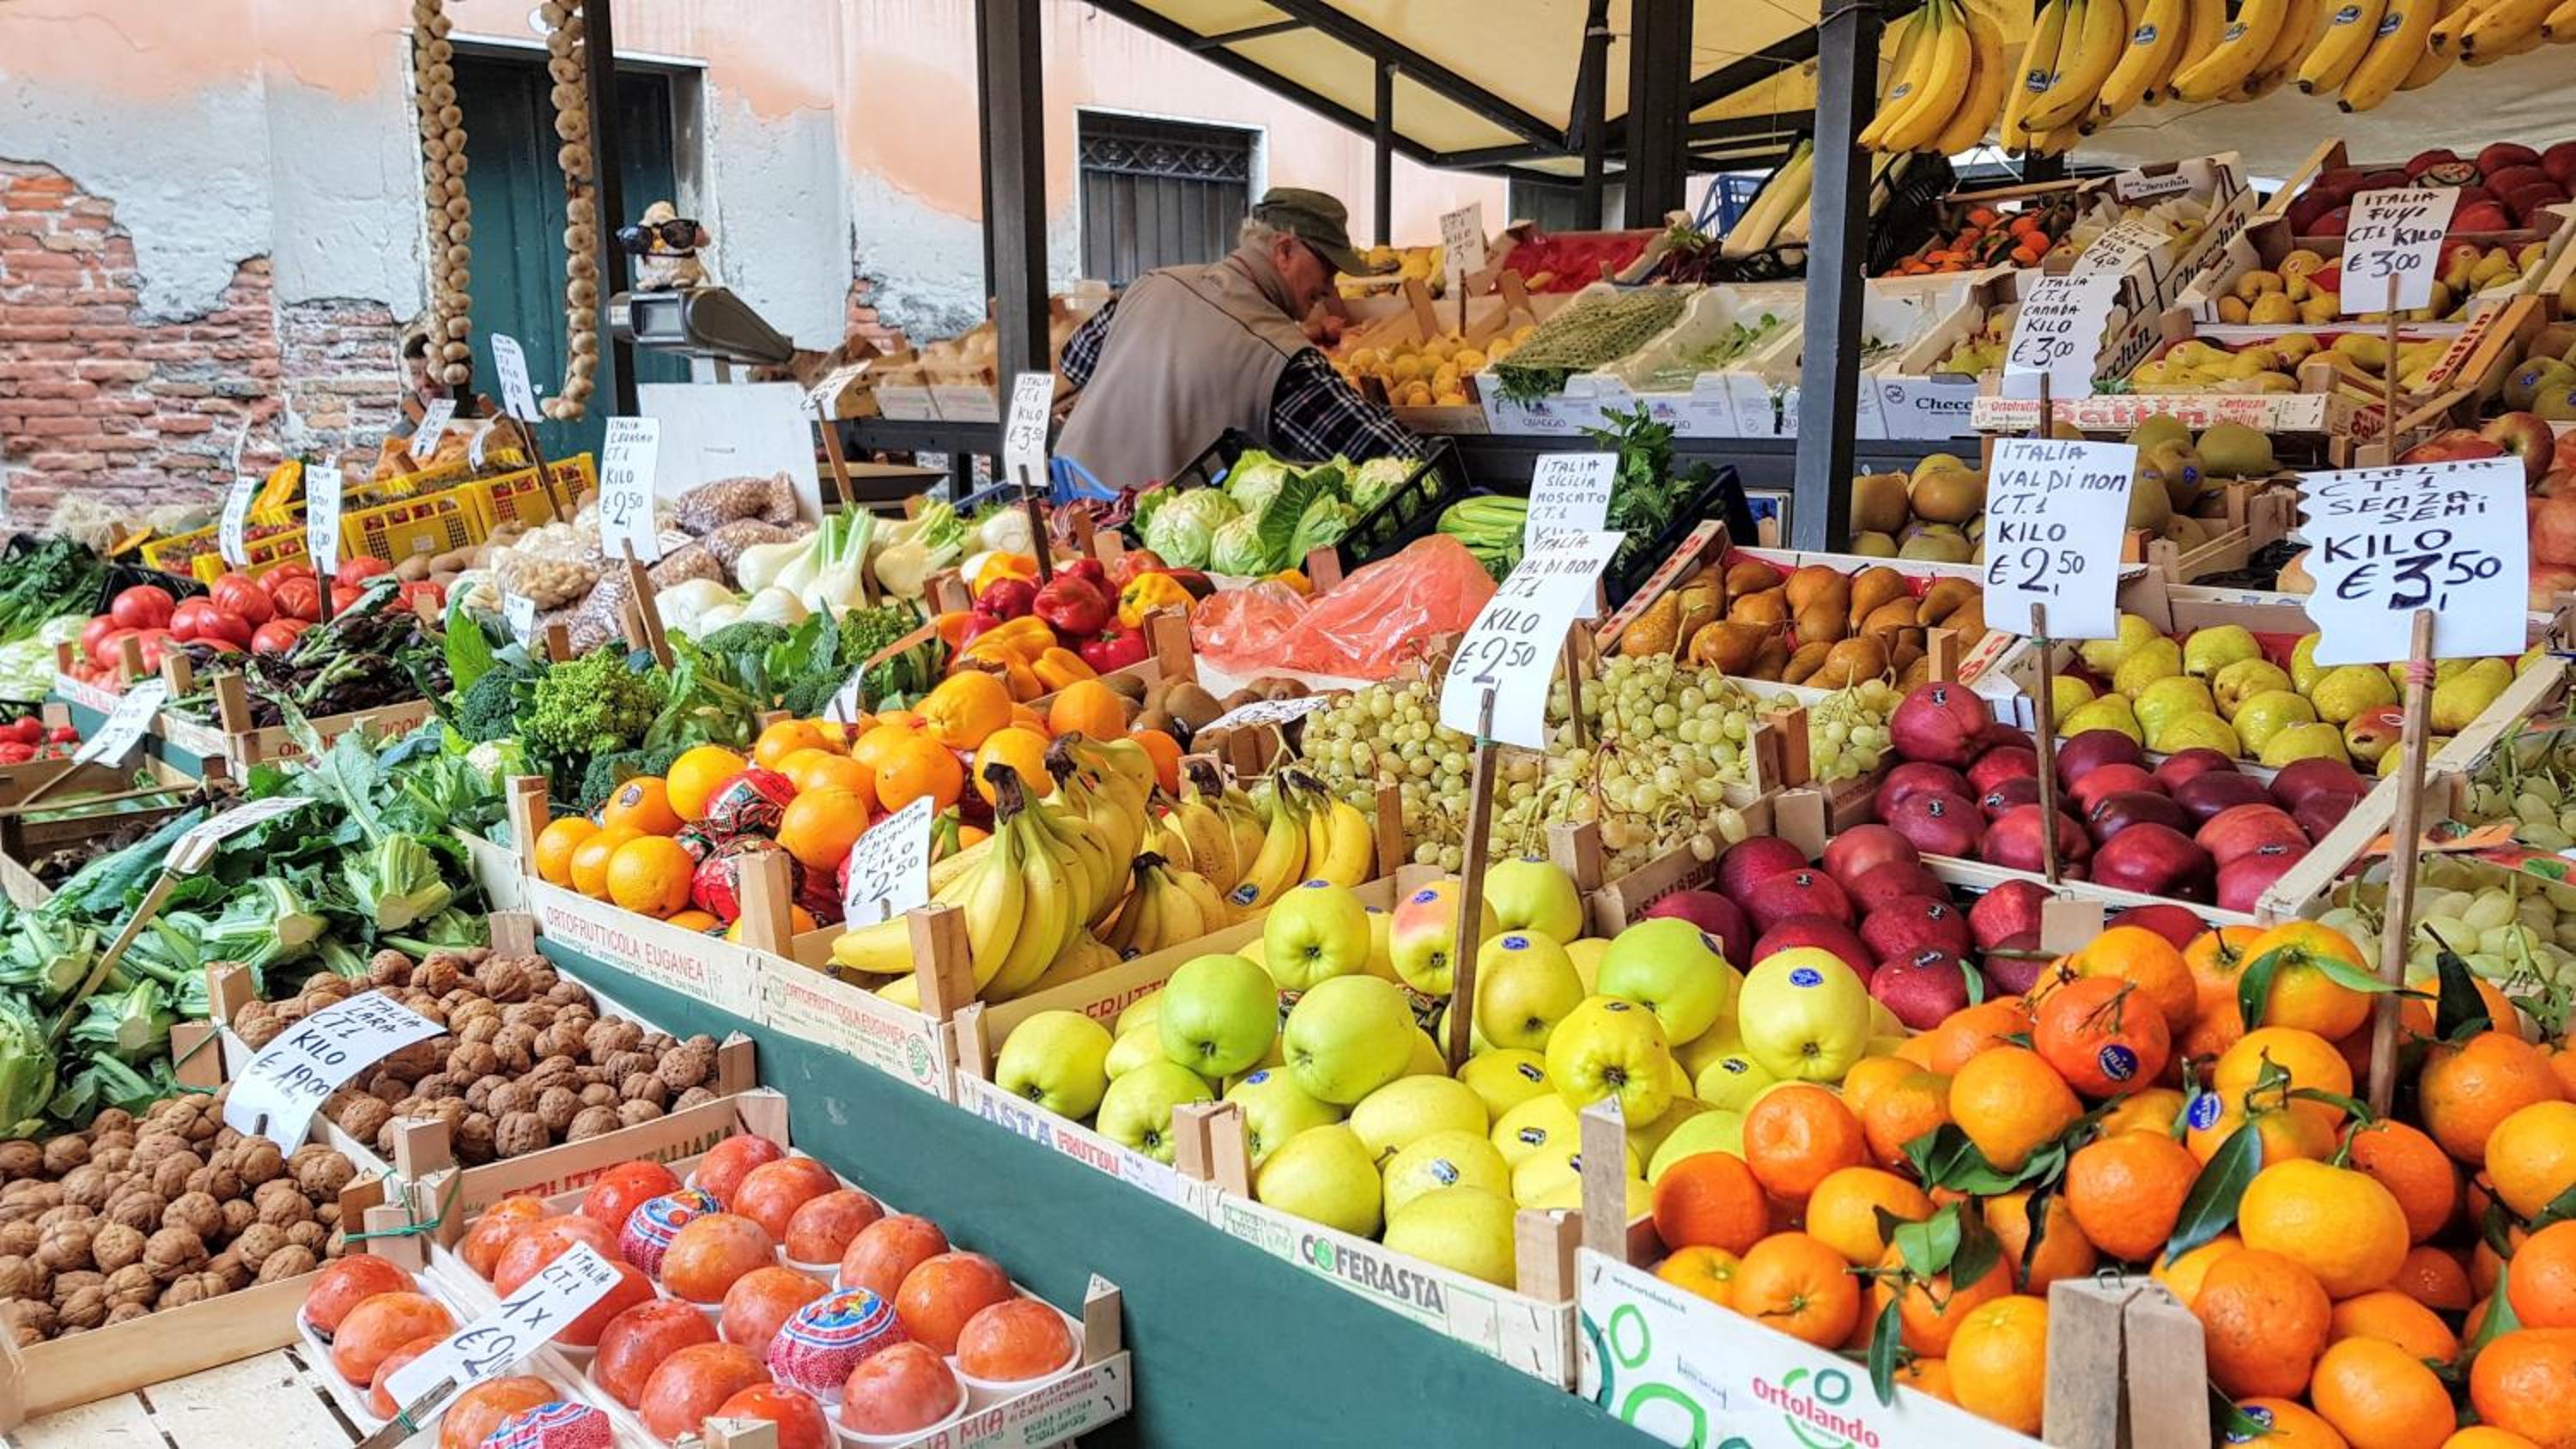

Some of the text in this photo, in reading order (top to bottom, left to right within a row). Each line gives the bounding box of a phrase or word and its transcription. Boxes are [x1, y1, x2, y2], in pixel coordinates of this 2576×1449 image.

[2365, 191, 2439, 207] ITALIA
[2392, 227, 2443, 246] KILO
[2038, 276, 2088, 288] ITALIA
[2026, 318, 2073, 334] KILO
[2012, 339, 2029, 363] €
[1018, 406, 1043, 421] KILO
[1916, 397, 1972, 410] Checc
[2003, 440, 2087, 462] ITALIA
[606, 467, 634, 485] KILO
[1542, 459, 1601, 473] ITALIA
[1546, 474, 1596, 488] SICILIA
[1535, 492, 1607, 505] MOSCATO
[1999, 520, 2067, 543] KILO
[1534, 537, 1589, 552] ITALIA
[2324, 529, 2452, 563] KILO
[1988, 555, 2009, 585] €
[2336, 563, 2380, 599] €
[1480, 607, 1540, 635] KILO
[1452, 641, 1478, 676] €
[865, 840, 914, 879] KILO
[546, 906, 641, 961] ORTOFRUTTICOLA
[645, 943, 705, 983] EUGANEA
[345, 1006, 398, 1034] LARA
[357, 994, 422, 1029] ITALIA
[289, 1028, 347, 1066] KILO
[249, 1051, 283, 1076] €
[568, 1247, 611, 1286] ITALIA
[1301, 1234, 1445, 1306] COFERASTA
[453, 1327, 501, 1350] €
[1752, 1377, 1880, 1448] Ortolando
[959, 1408, 1005, 1443] MIA
